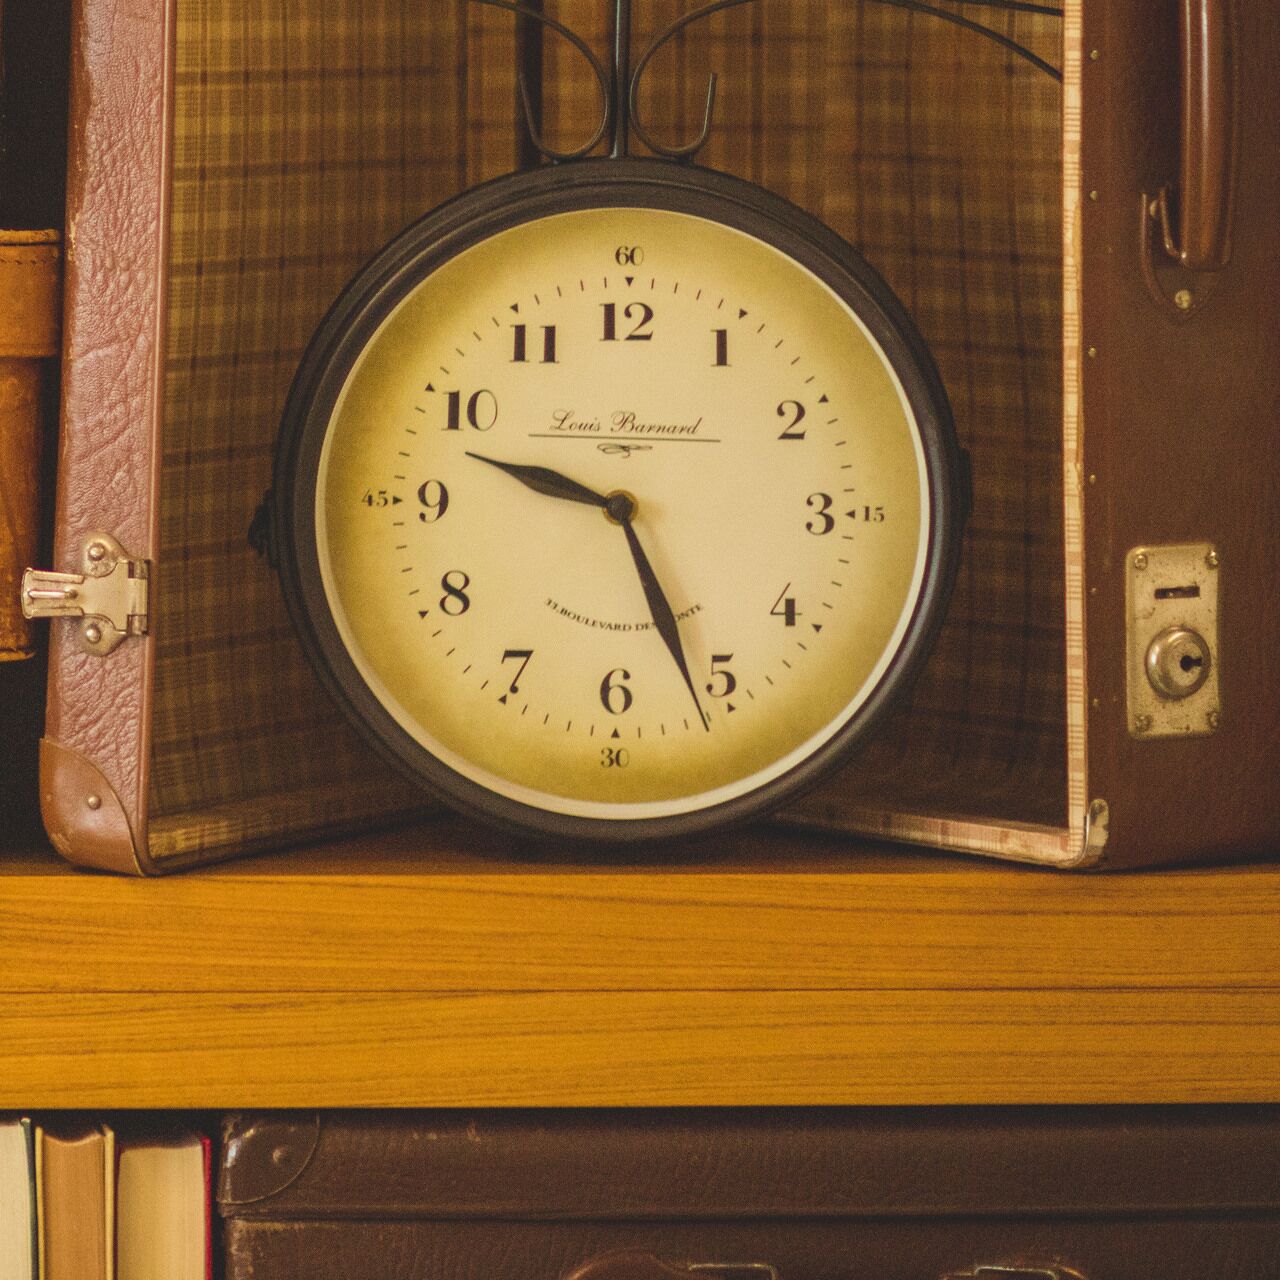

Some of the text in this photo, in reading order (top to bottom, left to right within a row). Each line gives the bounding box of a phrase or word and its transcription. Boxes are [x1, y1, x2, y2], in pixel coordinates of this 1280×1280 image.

[615, 246, 644, 266] 60
[599, 302, 654, 342] 12
[510, 324, 560, 364] 11
[711, 329, 732, 368] 1
[441, 388, 498, 432] 10
[550, 409, 703, 435] Louis Barnard
[776, 400, 807, 441] 2
[361, 490, 389, 508] 45
[418, 480, 449, 523] 9
[805, 493, 835, 536] 3
[862, 506, 886, 524] 15
[439, 570, 471, 616] 8
[770, 583, 802, 628] 4
[501, 649, 534, 695] 7
[599, 668, 633, 715] 6
[706, 653, 737, 698] 5
[601, 747, 631, 768] 30
